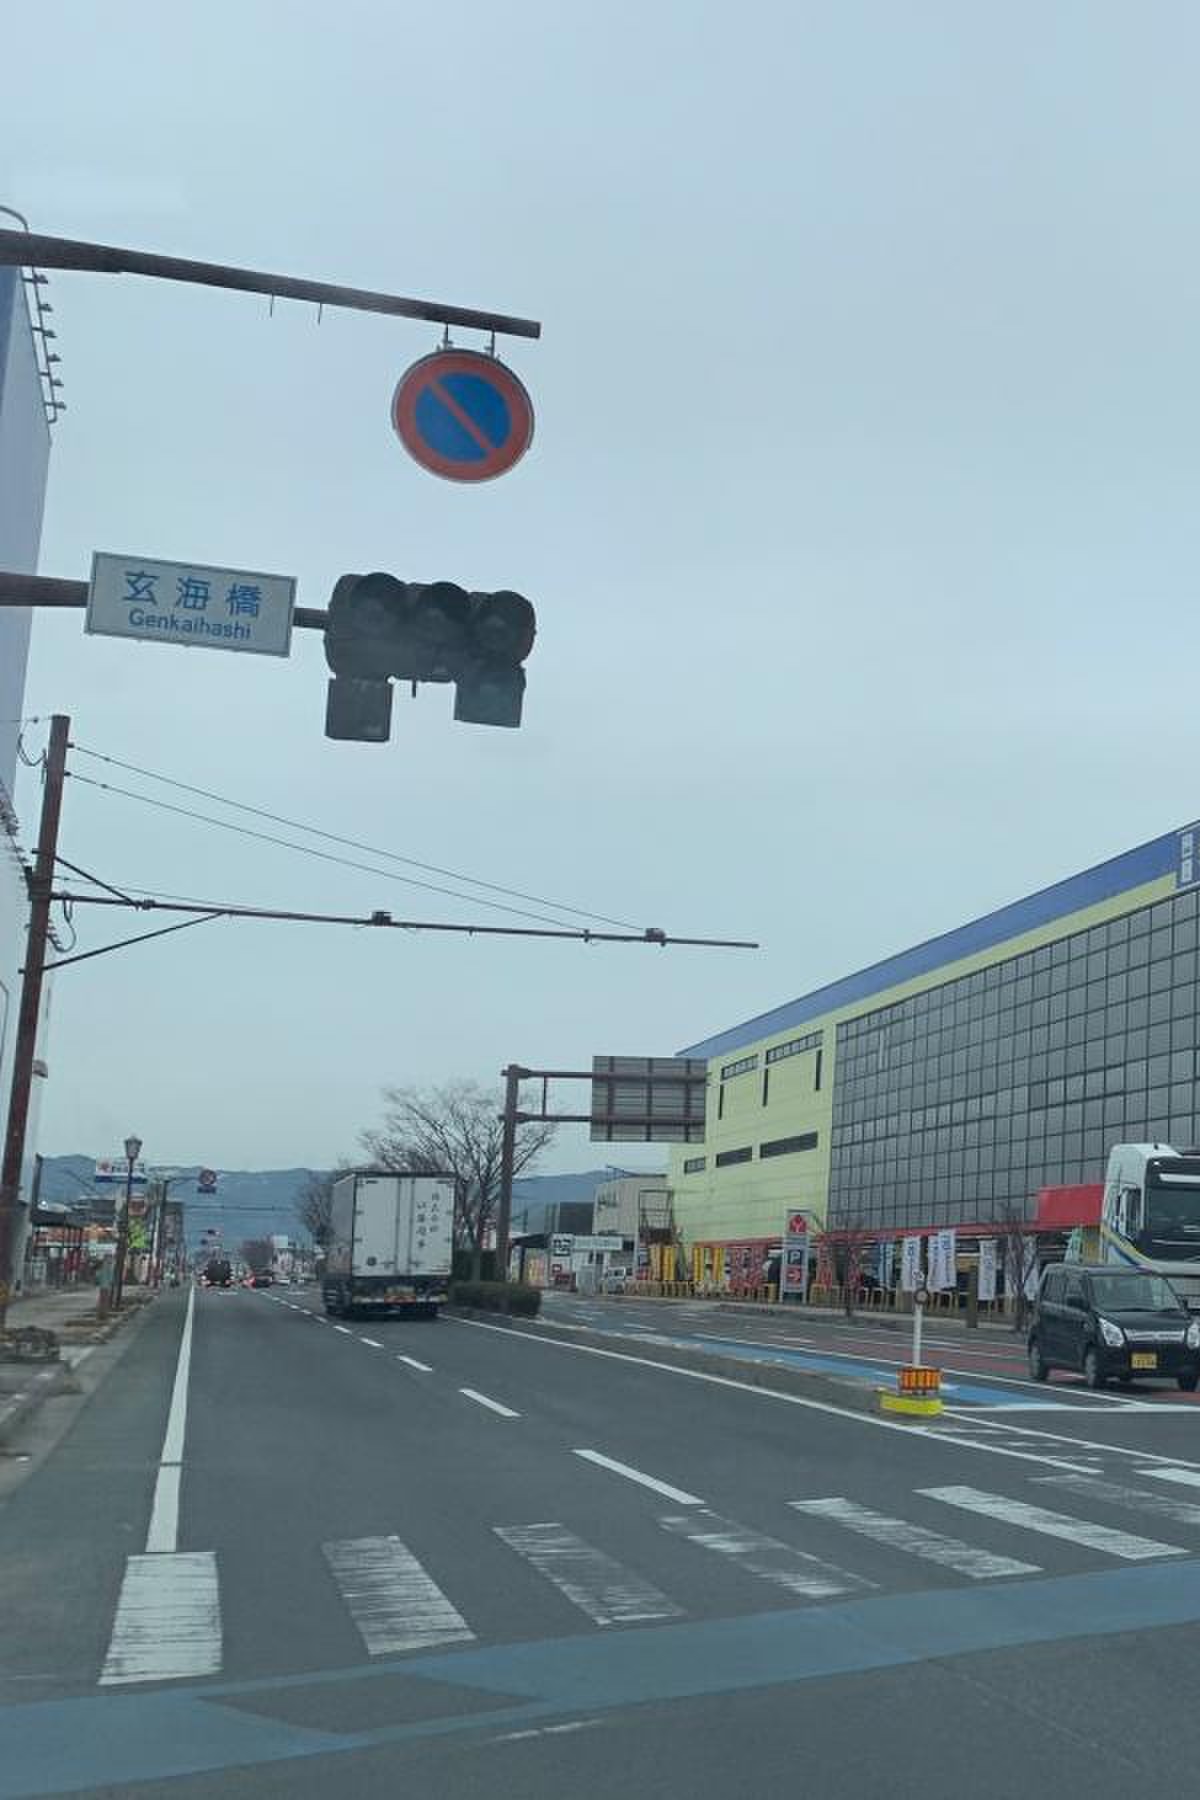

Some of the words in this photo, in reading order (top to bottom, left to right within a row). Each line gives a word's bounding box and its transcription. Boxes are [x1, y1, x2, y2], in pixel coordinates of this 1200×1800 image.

[122, 571, 262, 618] 玄海橋
[128, 608, 251, 639] Genkaihashi
